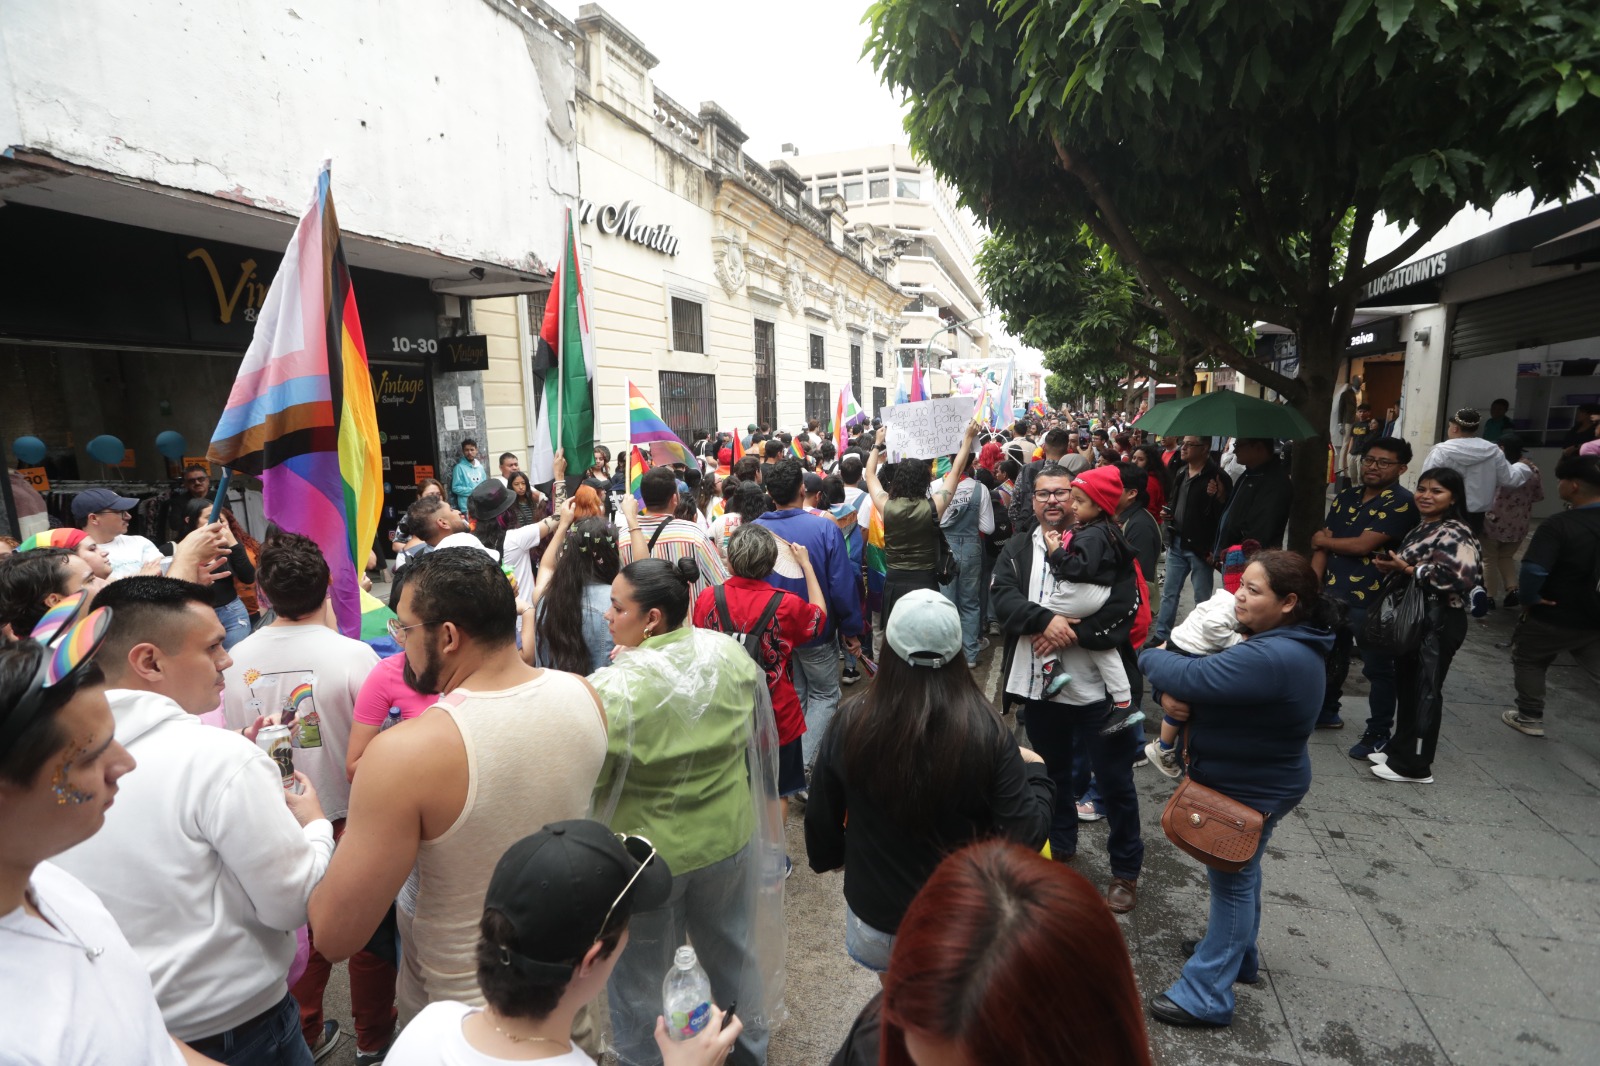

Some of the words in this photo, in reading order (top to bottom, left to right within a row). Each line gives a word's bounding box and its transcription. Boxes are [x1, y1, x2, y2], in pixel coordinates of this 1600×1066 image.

[596, 200, 680, 257] Martin
[1367, 252, 1447, 298] LUCCATONNYS
[391, 336, 438, 354] 10-30
[1350, 332, 1374, 346] asiva
[370, 369, 424, 404] Vintage
[916, 406, 928, 417] no
[933, 401, 956, 417] hay
[934, 414, 963, 428] para
[945, 434, 958, 447] yo
